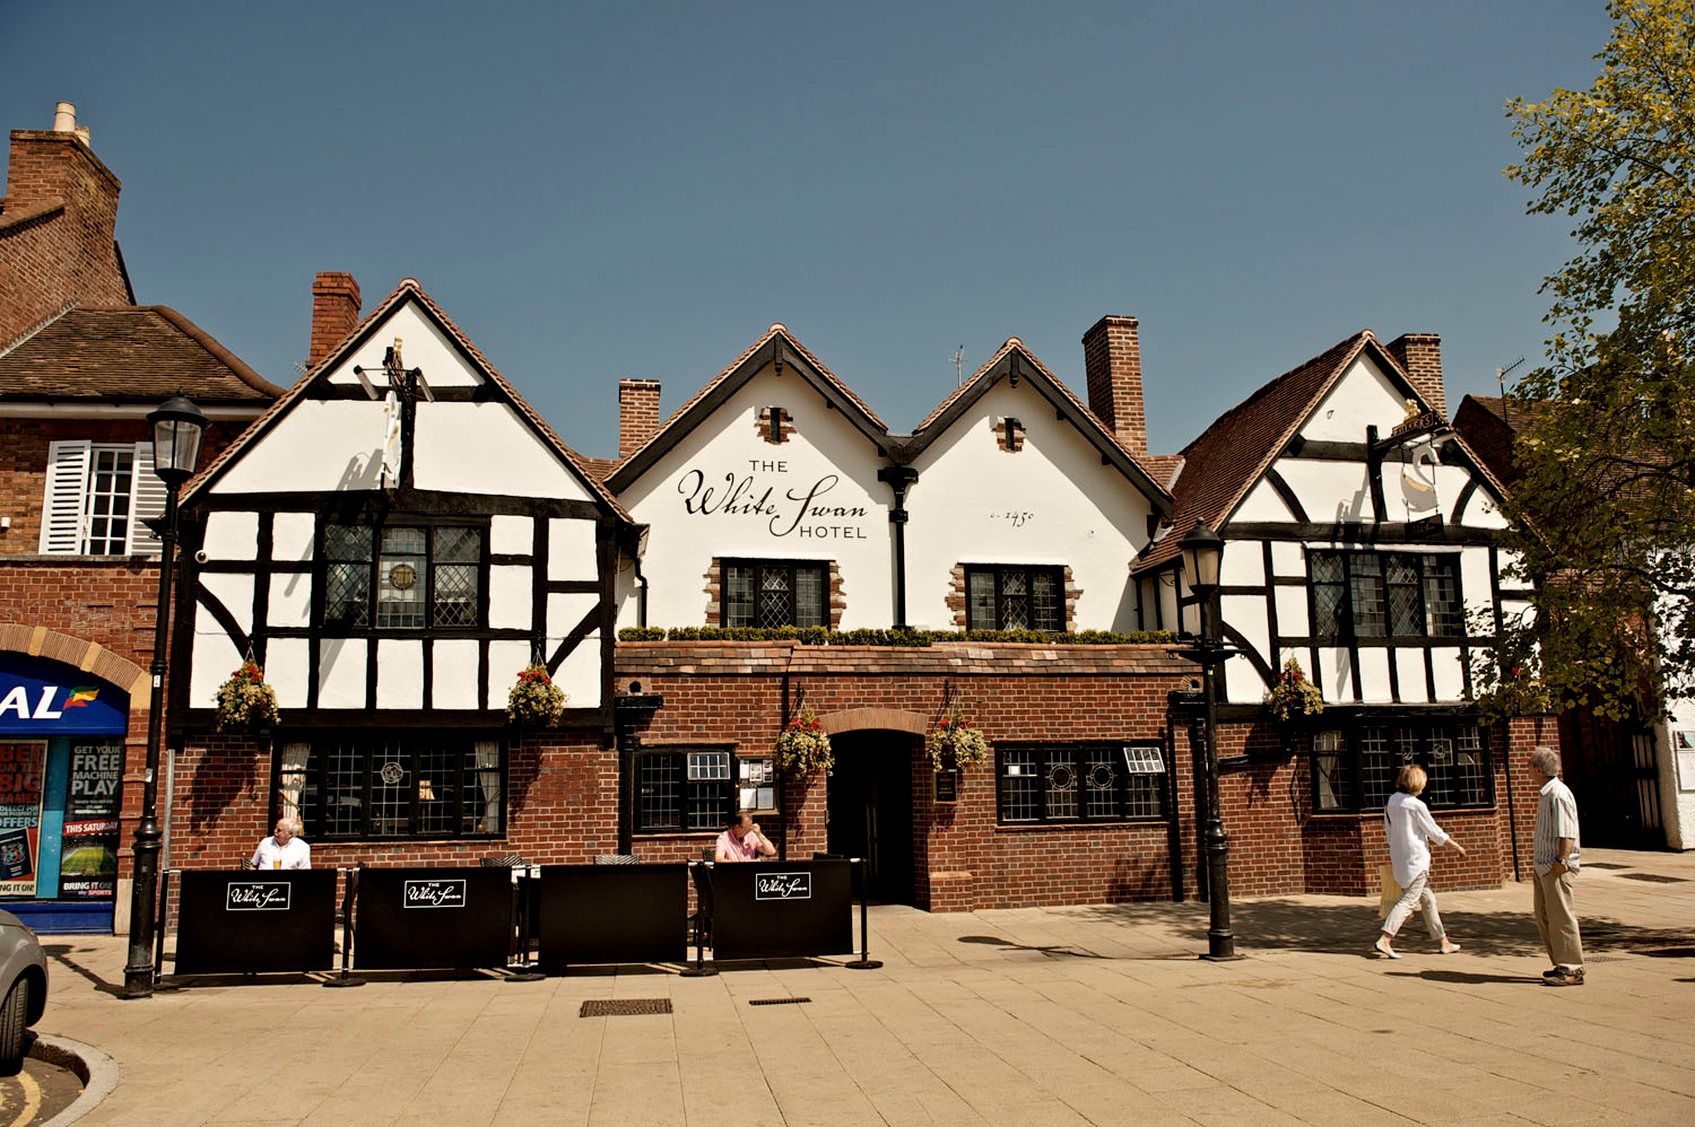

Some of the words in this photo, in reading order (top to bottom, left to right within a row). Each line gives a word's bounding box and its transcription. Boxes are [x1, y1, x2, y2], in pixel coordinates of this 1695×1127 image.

[749, 460, 788, 473] THE
[678, 469, 779, 515] White
[769, 475, 867, 537] Swan
[800, 526, 867, 539] HOTEL
[74, 745, 94, 754] GET
[96, 745, 120, 754] YOUR
[73, 755, 119, 771] FREE
[72, 771, 118, 780] MACHINE
[71, 780, 118, 795] PLAY
[66, 824, 83, 834] THIS
[83, 822, 118, 832] SATURDAY
[63, 882, 90, 890] BRING
[91, 881, 99, 889] IT
[759, 879, 786, 892] White
[231, 888, 261, 902] White
[408, 886, 437, 900] White
